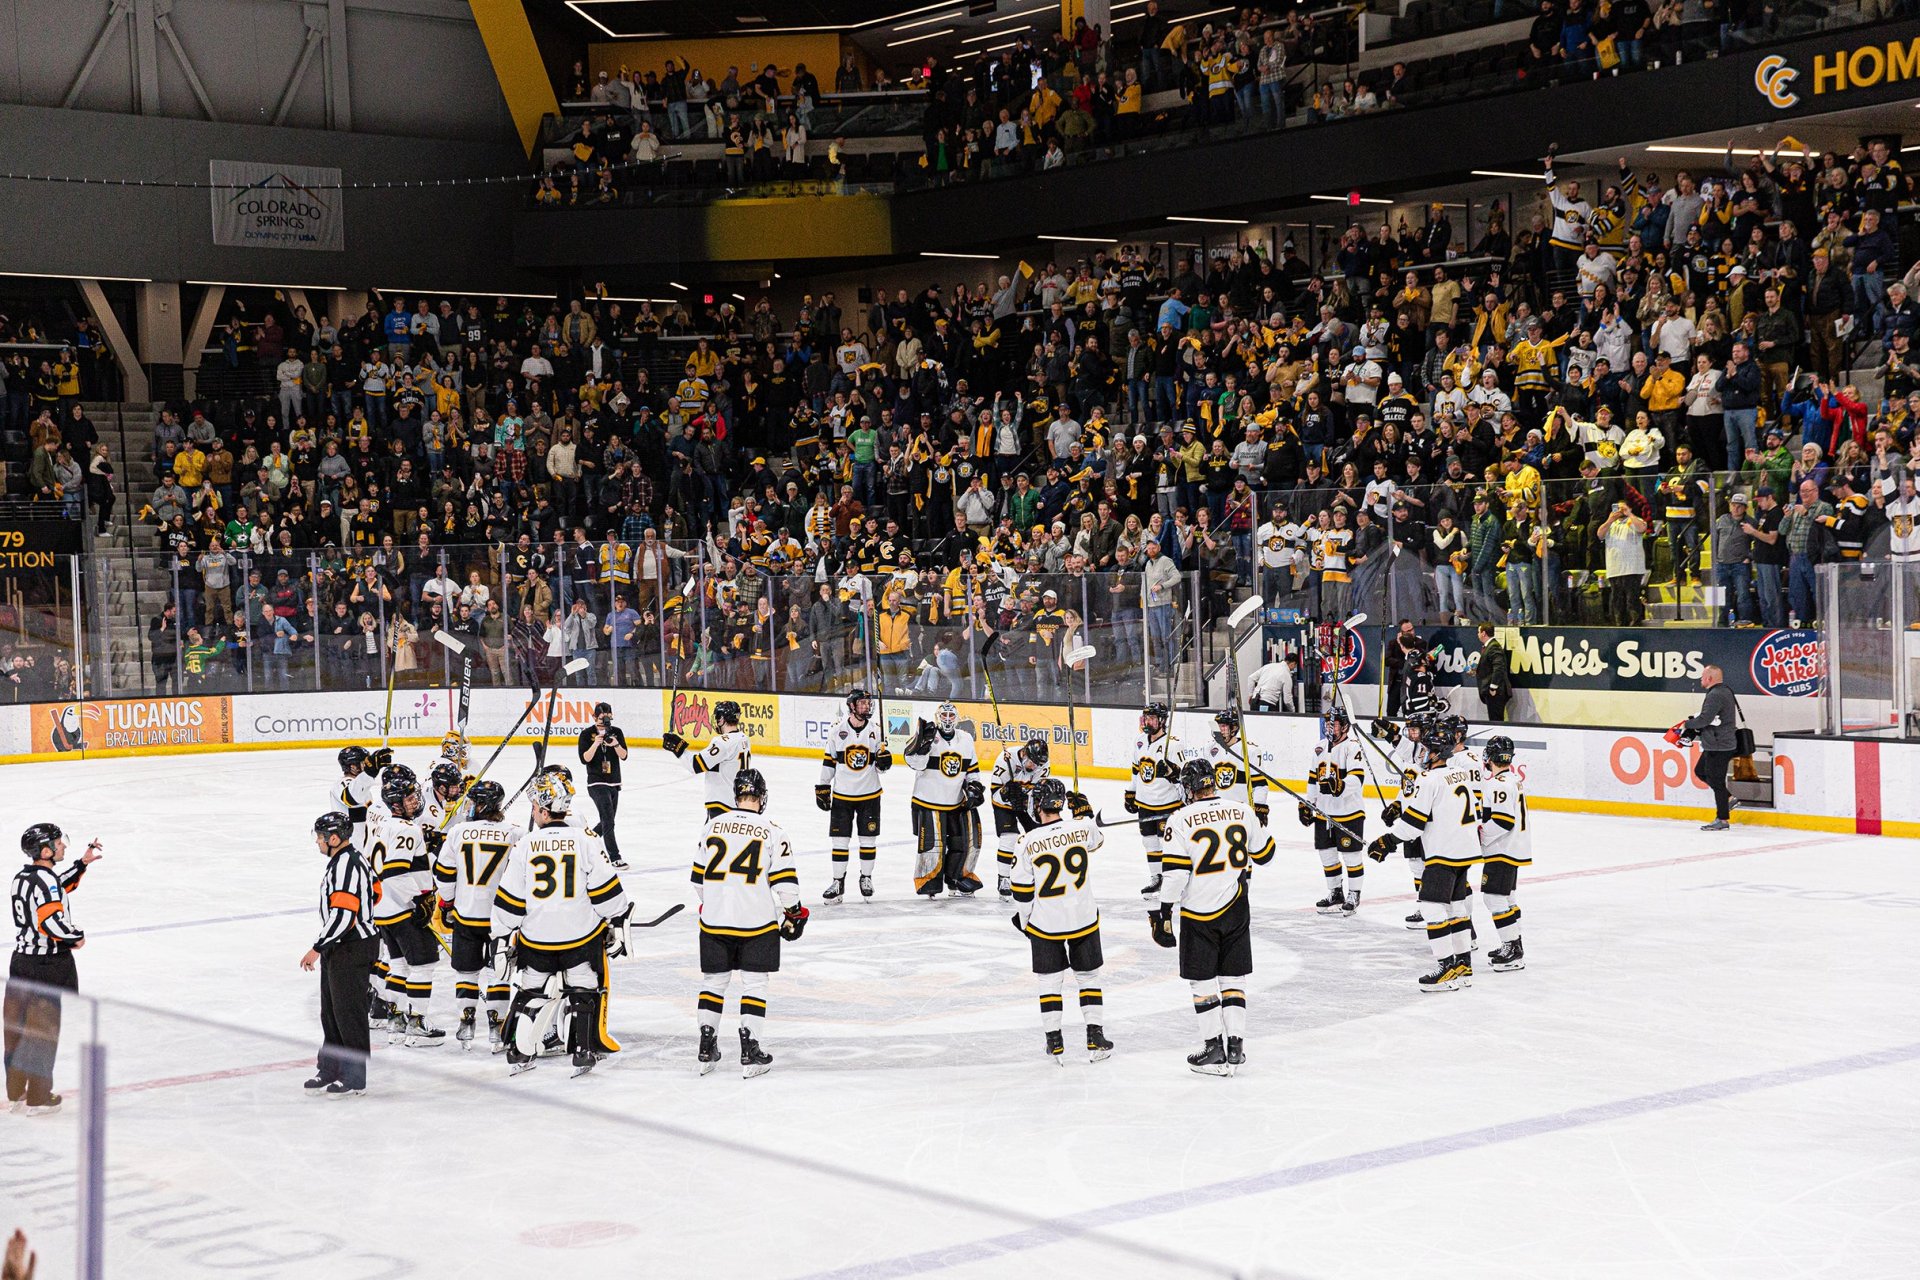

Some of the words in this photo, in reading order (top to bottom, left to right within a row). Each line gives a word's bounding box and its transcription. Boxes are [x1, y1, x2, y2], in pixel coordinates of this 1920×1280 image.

[1814, 36, 1920, 95] HOM
[238, 199, 321, 220] COLORADO
[256, 215, 305, 229] SPRINGS
[244, 230, 280, 241] OLYMPIC
[467, 329, 481, 342] 99
[1775, 633, 1791, 643] SINCE
[1437, 646, 1482, 673] rse
[1510, 635, 1608, 676] Mike's
[461, 657, 472, 707] BAUER
[1787, 682, 1812, 695] SUBS
[104, 700, 204, 730] TUCANOS
[525, 701, 600, 724] NUNN
[672, 692, 713, 738] Rudy's
[741, 702, 774, 720] TEXAS
[887, 708, 911, 716] URBAN
[254, 712, 421, 735] CommonSpirit
[526, 726, 585, 736] CONSTRUCT
[805, 720, 832, 740] PE
[981, 723, 1017, 742] Black
[1019, 724, 1050, 742] Bear
[105, 730, 168, 747] BRAZILIAN
[171, 728, 204, 744] GRILL
[868, 731, 876, 740] A
[1156, 744, 1163, 754] A
[1354, 751, 1363, 762] 4
[993, 765, 1006, 777] 27
[1468, 769, 1481, 783] 18
[1454, 784, 1476, 826] 2
[1492, 789, 1508, 804] 19
[1518, 793, 1526, 832] 1
[462, 829, 510, 842] COFFEY
[712, 822, 770, 840] EINBERGS
[1164, 826, 1173, 843] 8
[395, 835, 415, 851] 20
[530, 839, 576, 853] WILDER
[1026, 829, 1090, 856] MONTGOMERY
[1190, 824, 1249, 877] 28
[460, 842, 512, 887] 17
[600, 849, 610, 864] 3
[704, 835, 765, 885] 24
[1011, 855, 1018, 870] 9
[529, 853, 577, 900] 31
[1032, 846, 1089, 899] 29
[15, 899, 27, 926] 9
